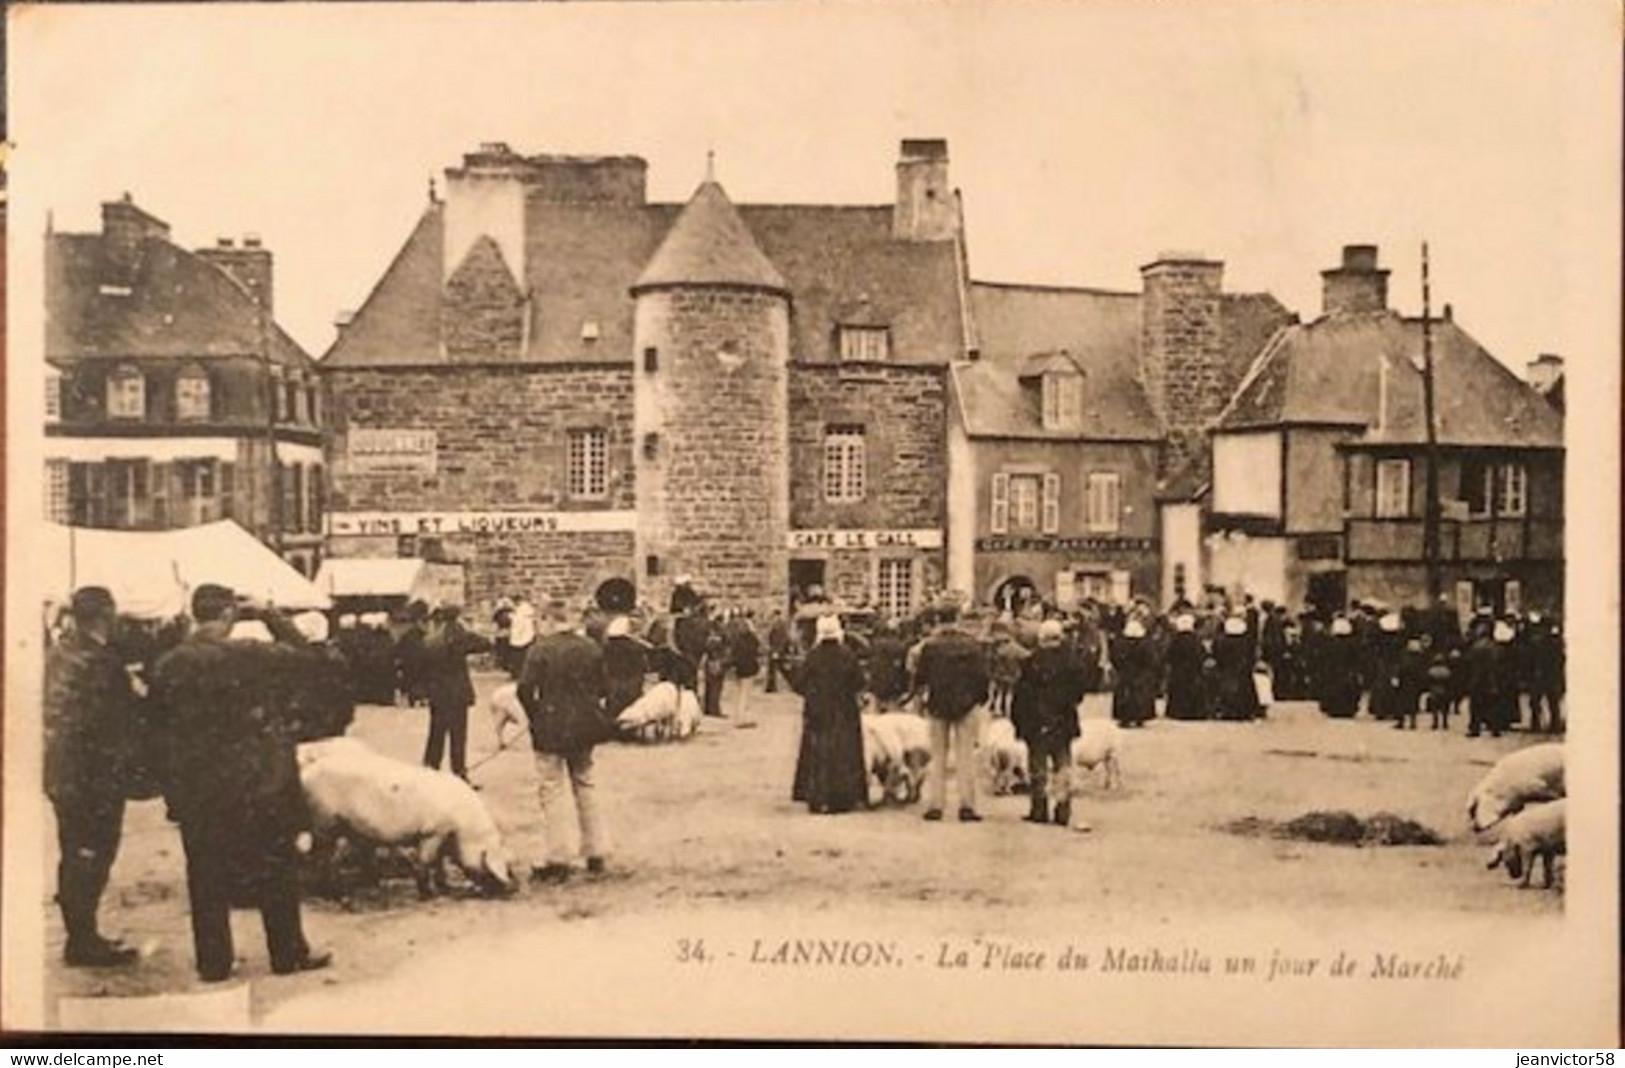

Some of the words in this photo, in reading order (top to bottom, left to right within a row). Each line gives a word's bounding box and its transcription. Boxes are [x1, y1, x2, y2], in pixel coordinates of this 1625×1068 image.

[417, 517, 444, 534] ET
[458, 516, 559, 535] LIQUEURS
[794, 533, 836, 546] CAFE
[846, 533, 865, 546] LE
